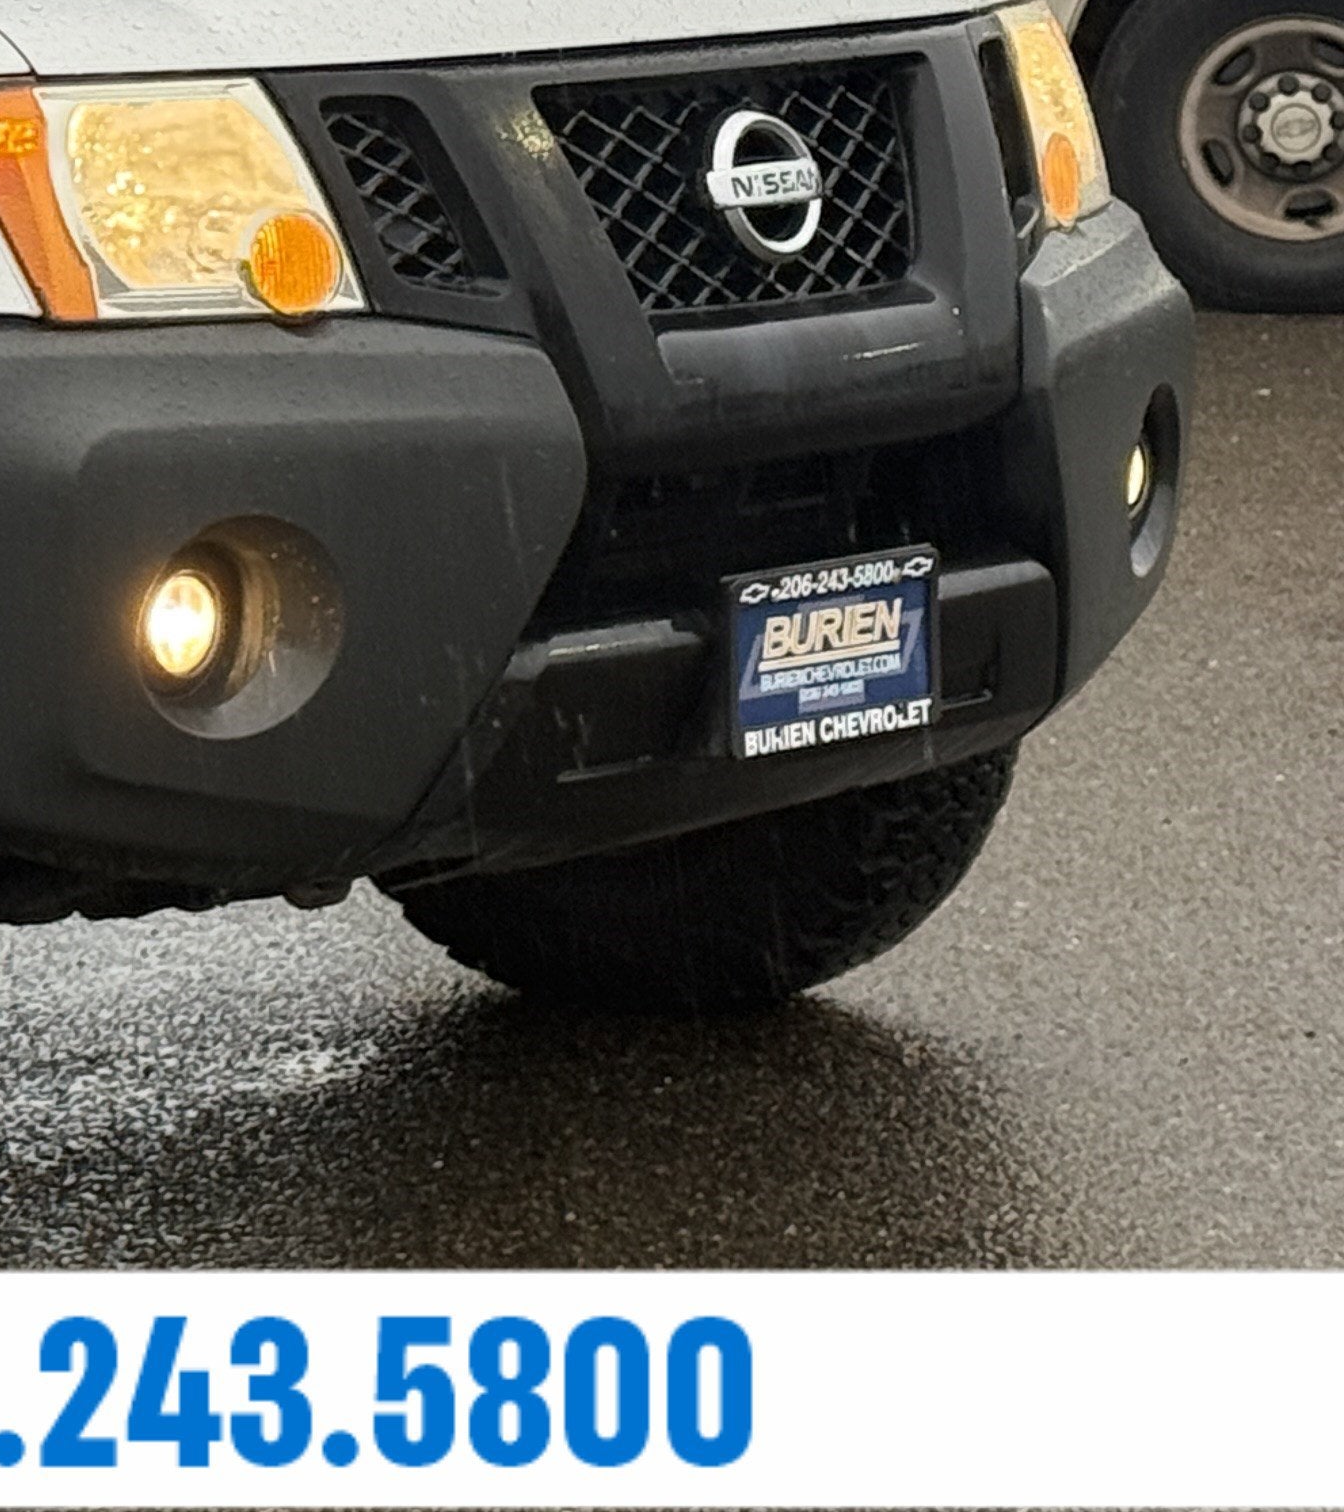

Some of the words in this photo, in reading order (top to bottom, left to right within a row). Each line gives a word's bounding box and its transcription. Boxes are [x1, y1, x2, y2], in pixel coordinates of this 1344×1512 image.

[730, 167, 819, 199] NISSAN
[779, 560, 894, 601] 206-243-5800
[763, 597, 903, 660] BURIEN
[744, 709, 816, 758] BURIEN
[819, 698, 933, 743] CHEVROLET
